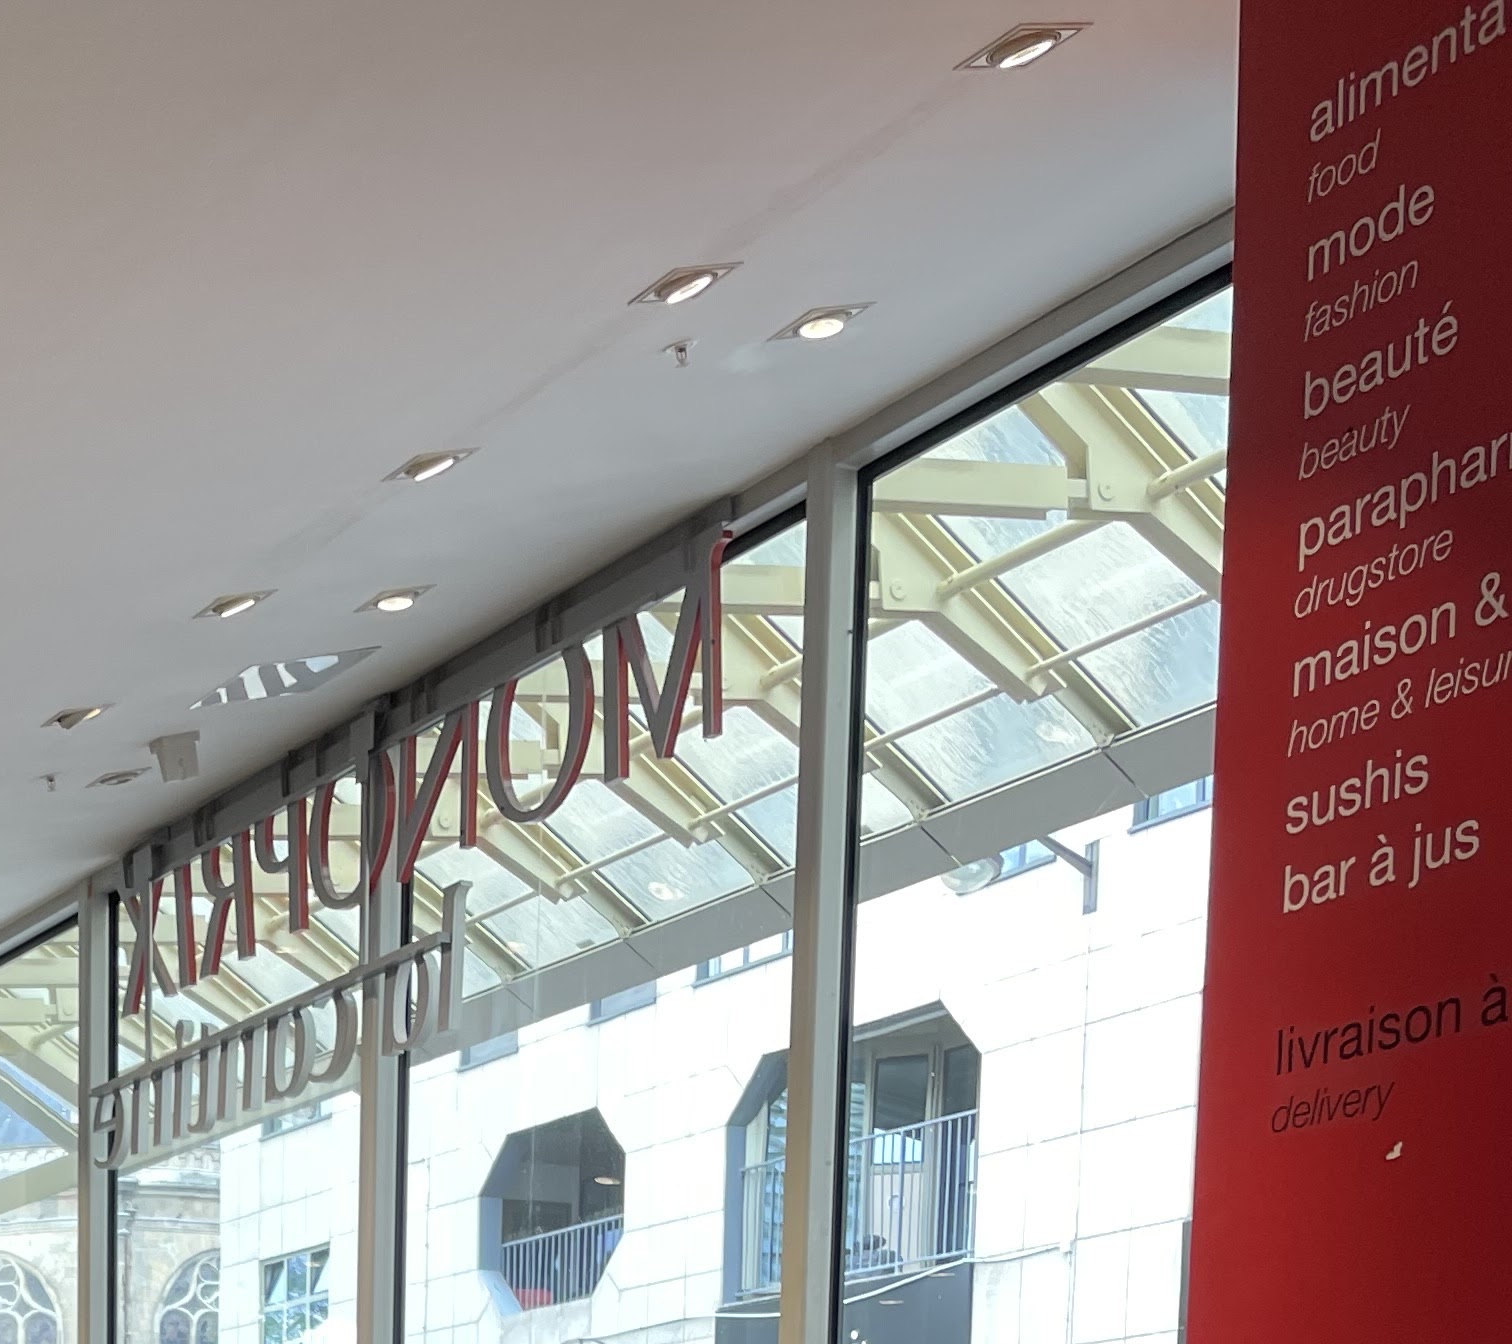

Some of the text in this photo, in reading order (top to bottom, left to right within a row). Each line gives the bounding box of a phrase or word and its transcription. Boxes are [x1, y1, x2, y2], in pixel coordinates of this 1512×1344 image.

[1307, 128, 1381, 203] food
[1308, 184, 1435, 281] mode
[1304, 260, 1419, 342] fashion
[1303, 300, 1458, 420] beauté
[1299, 404, 1411, 480] beauty
[1299, 433, 1512, 572] paraphar
[1294, 529, 1454, 619] drugstore
[1292, 571, 1510, 697] maison &
[1287, 699, 1380, 758] home
[1391, 678, 1414, 720] &
[1286, 749, 1430, 834] sushis
[1283, 819, 1480, 914] bar à jus
[1276, 973, 1509, 1076] livraison à
[1271, 1081, 1396, 1133] delivery
